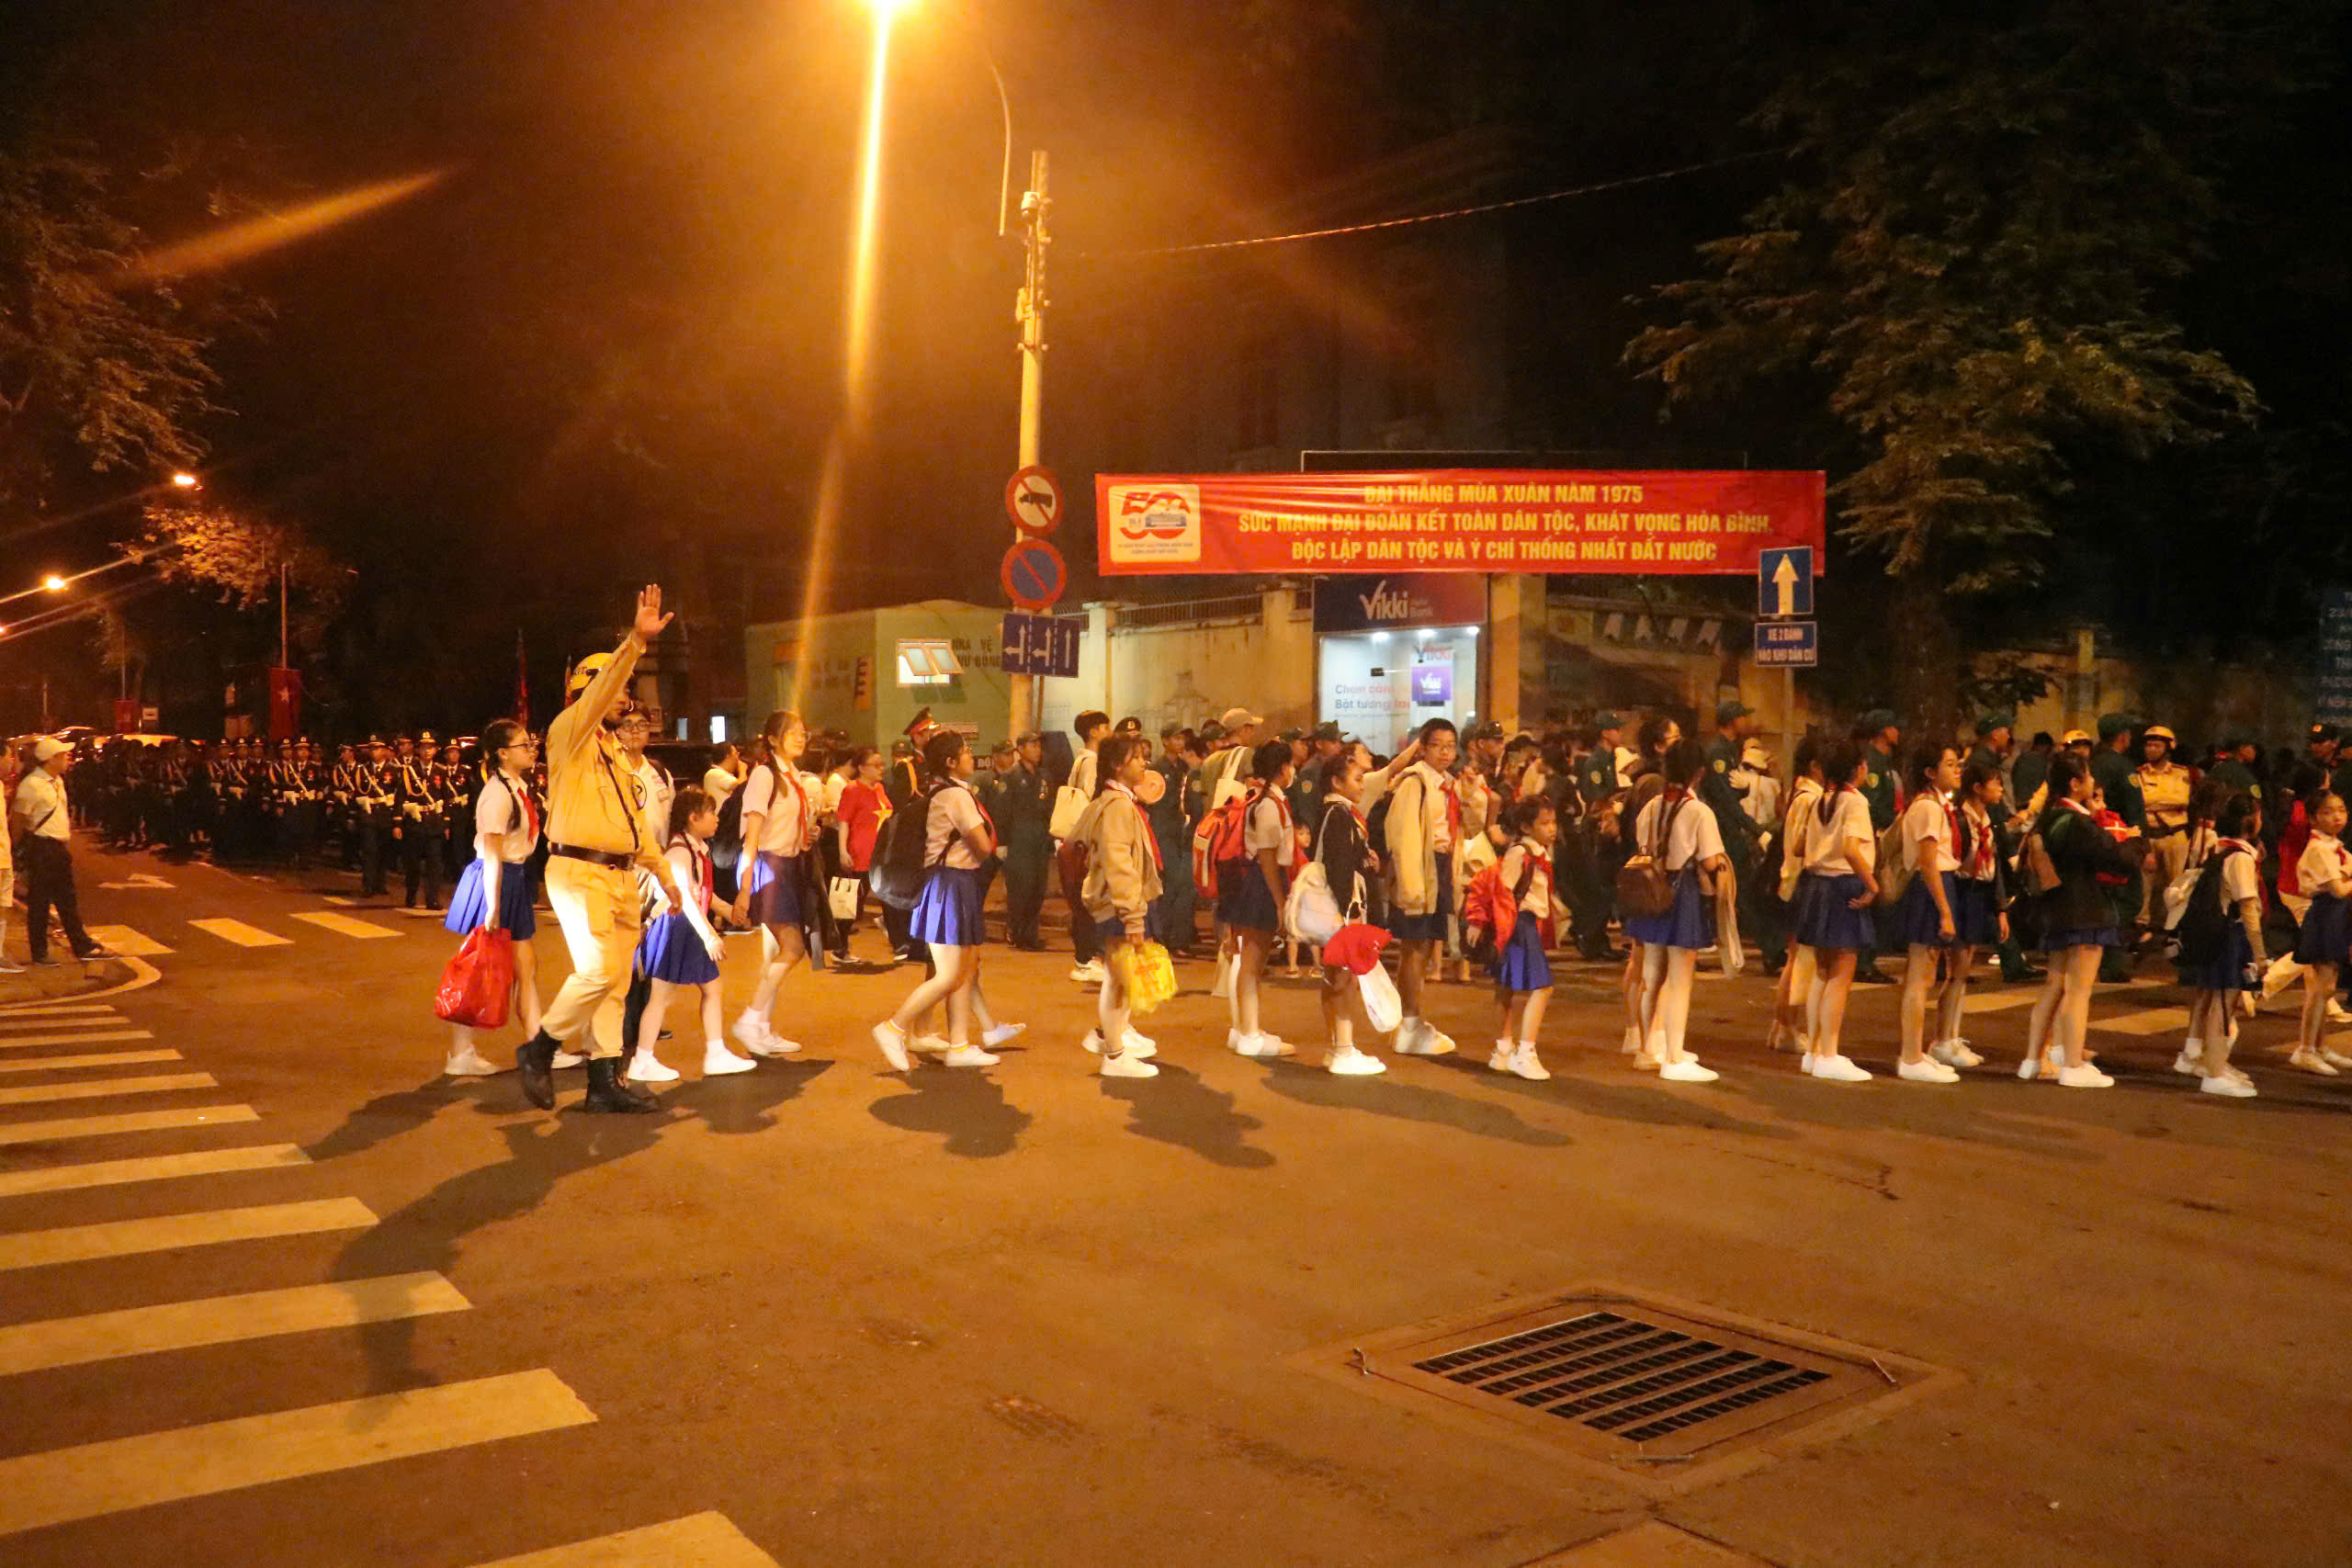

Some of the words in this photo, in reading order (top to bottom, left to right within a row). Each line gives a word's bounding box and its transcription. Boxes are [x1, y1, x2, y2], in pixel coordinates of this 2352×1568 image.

[1363, 485, 1394, 507] ĐẠI
[1398, 479, 1453, 503] THẮNG
[1458, 480, 1498, 503] MÙA
[1502, 481, 1550, 503] XUÂN
[1601, 484, 1644, 503] 1975
[1277, 513, 1327, 536] MẠNH
[1331, 513, 1361, 536] ĐẠI
[1364, 509, 1412, 531] ĐOÀN
[1416, 507, 1448, 531] KẾT
[1453, 509, 1497, 531] TOÀN
[1502, 509, 1538, 531] DÂN
[1543, 509, 1580, 535] TỘC,
[1585, 509, 1630, 532] KHÁT
[1634, 513, 1681, 536] VỌNG
[1292, 537, 1326, 564] ĐỘC
[1330, 537, 1362, 564] LẬP
[1366, 537, 1402, 559] DÂN
[1407, 537, 1439, 564] TỘC
[1443, 537, 1466, 559] VÀ
[1470, 537, 1482, 559] Ý
[1486, 537, 1515, 559] CHÍ
[1520, 535, 1577, 559] THỐNG
[1580, 535, 1627, 559] NHẤT
[1632, 535, 1664, 559] ĐẤT
[1668, 539, 1718, 560] NƯỚC
[1359, 580, 1408, 620] Vikki
